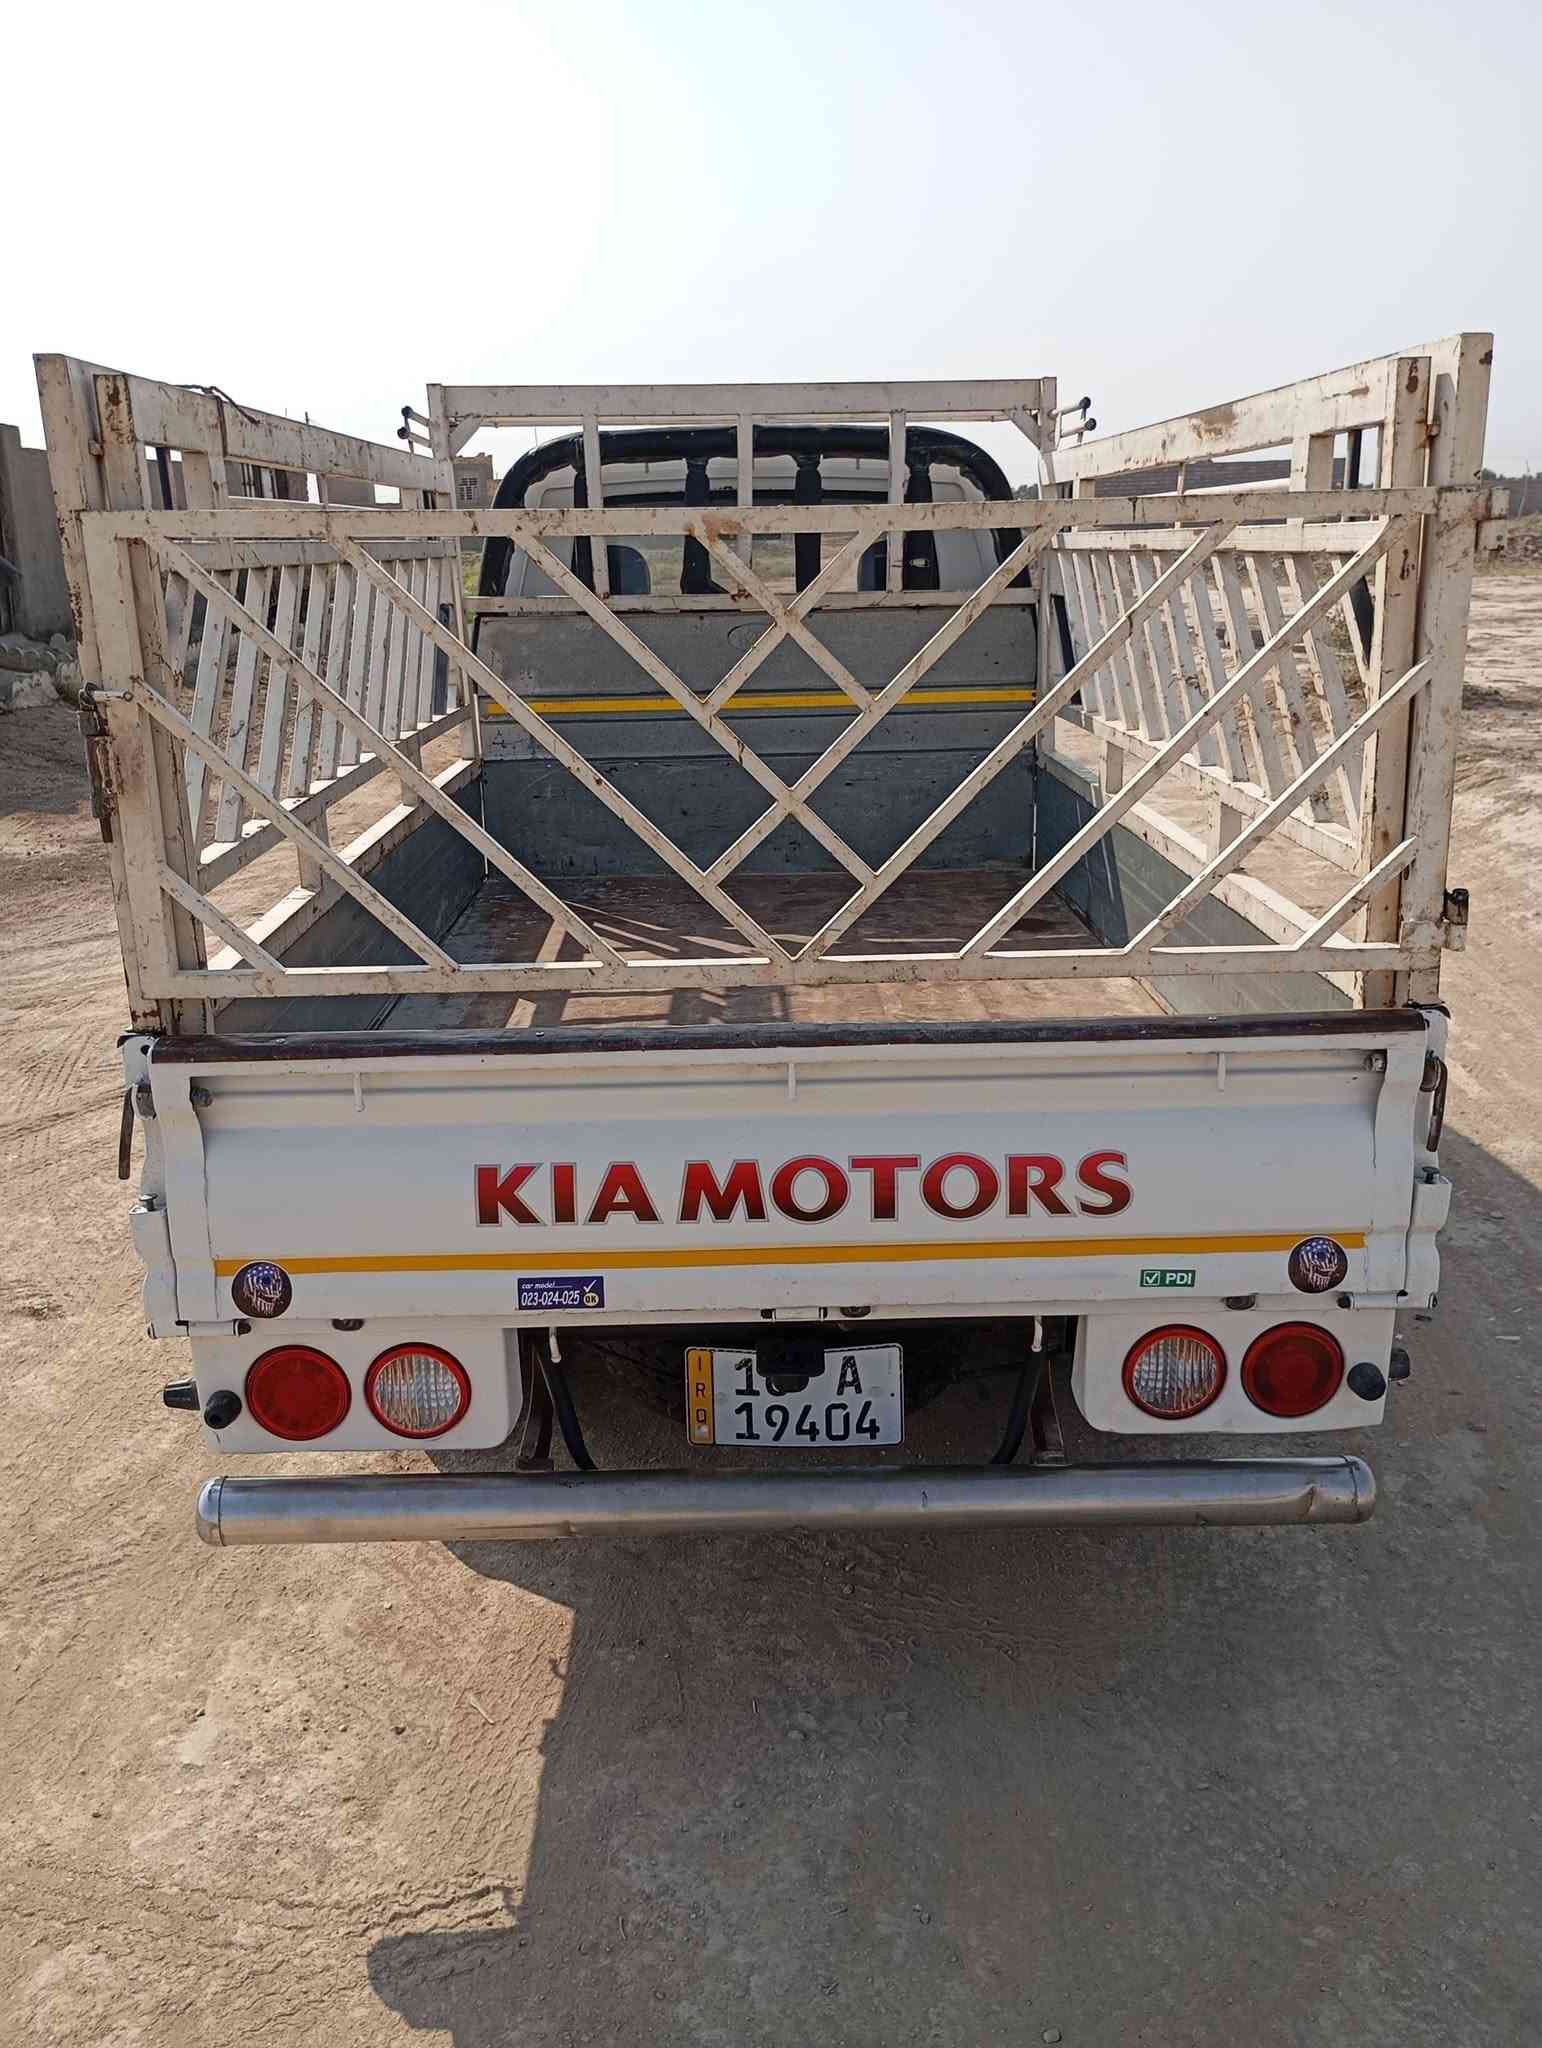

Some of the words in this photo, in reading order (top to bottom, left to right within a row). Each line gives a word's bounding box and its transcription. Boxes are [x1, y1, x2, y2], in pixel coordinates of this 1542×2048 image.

[474, 1162, 664, 1227] KIA
[676, 1149, 1134, 1224] MOTORS
[1166, 1272, 1192, 1285] PDI
[521, 1290, 580, 1306] 023-024-025
[585, 1294, 597, 1304] OK
[836, 1355, 862, 1396] A
[734, 1400, 881, 1443] 19404
